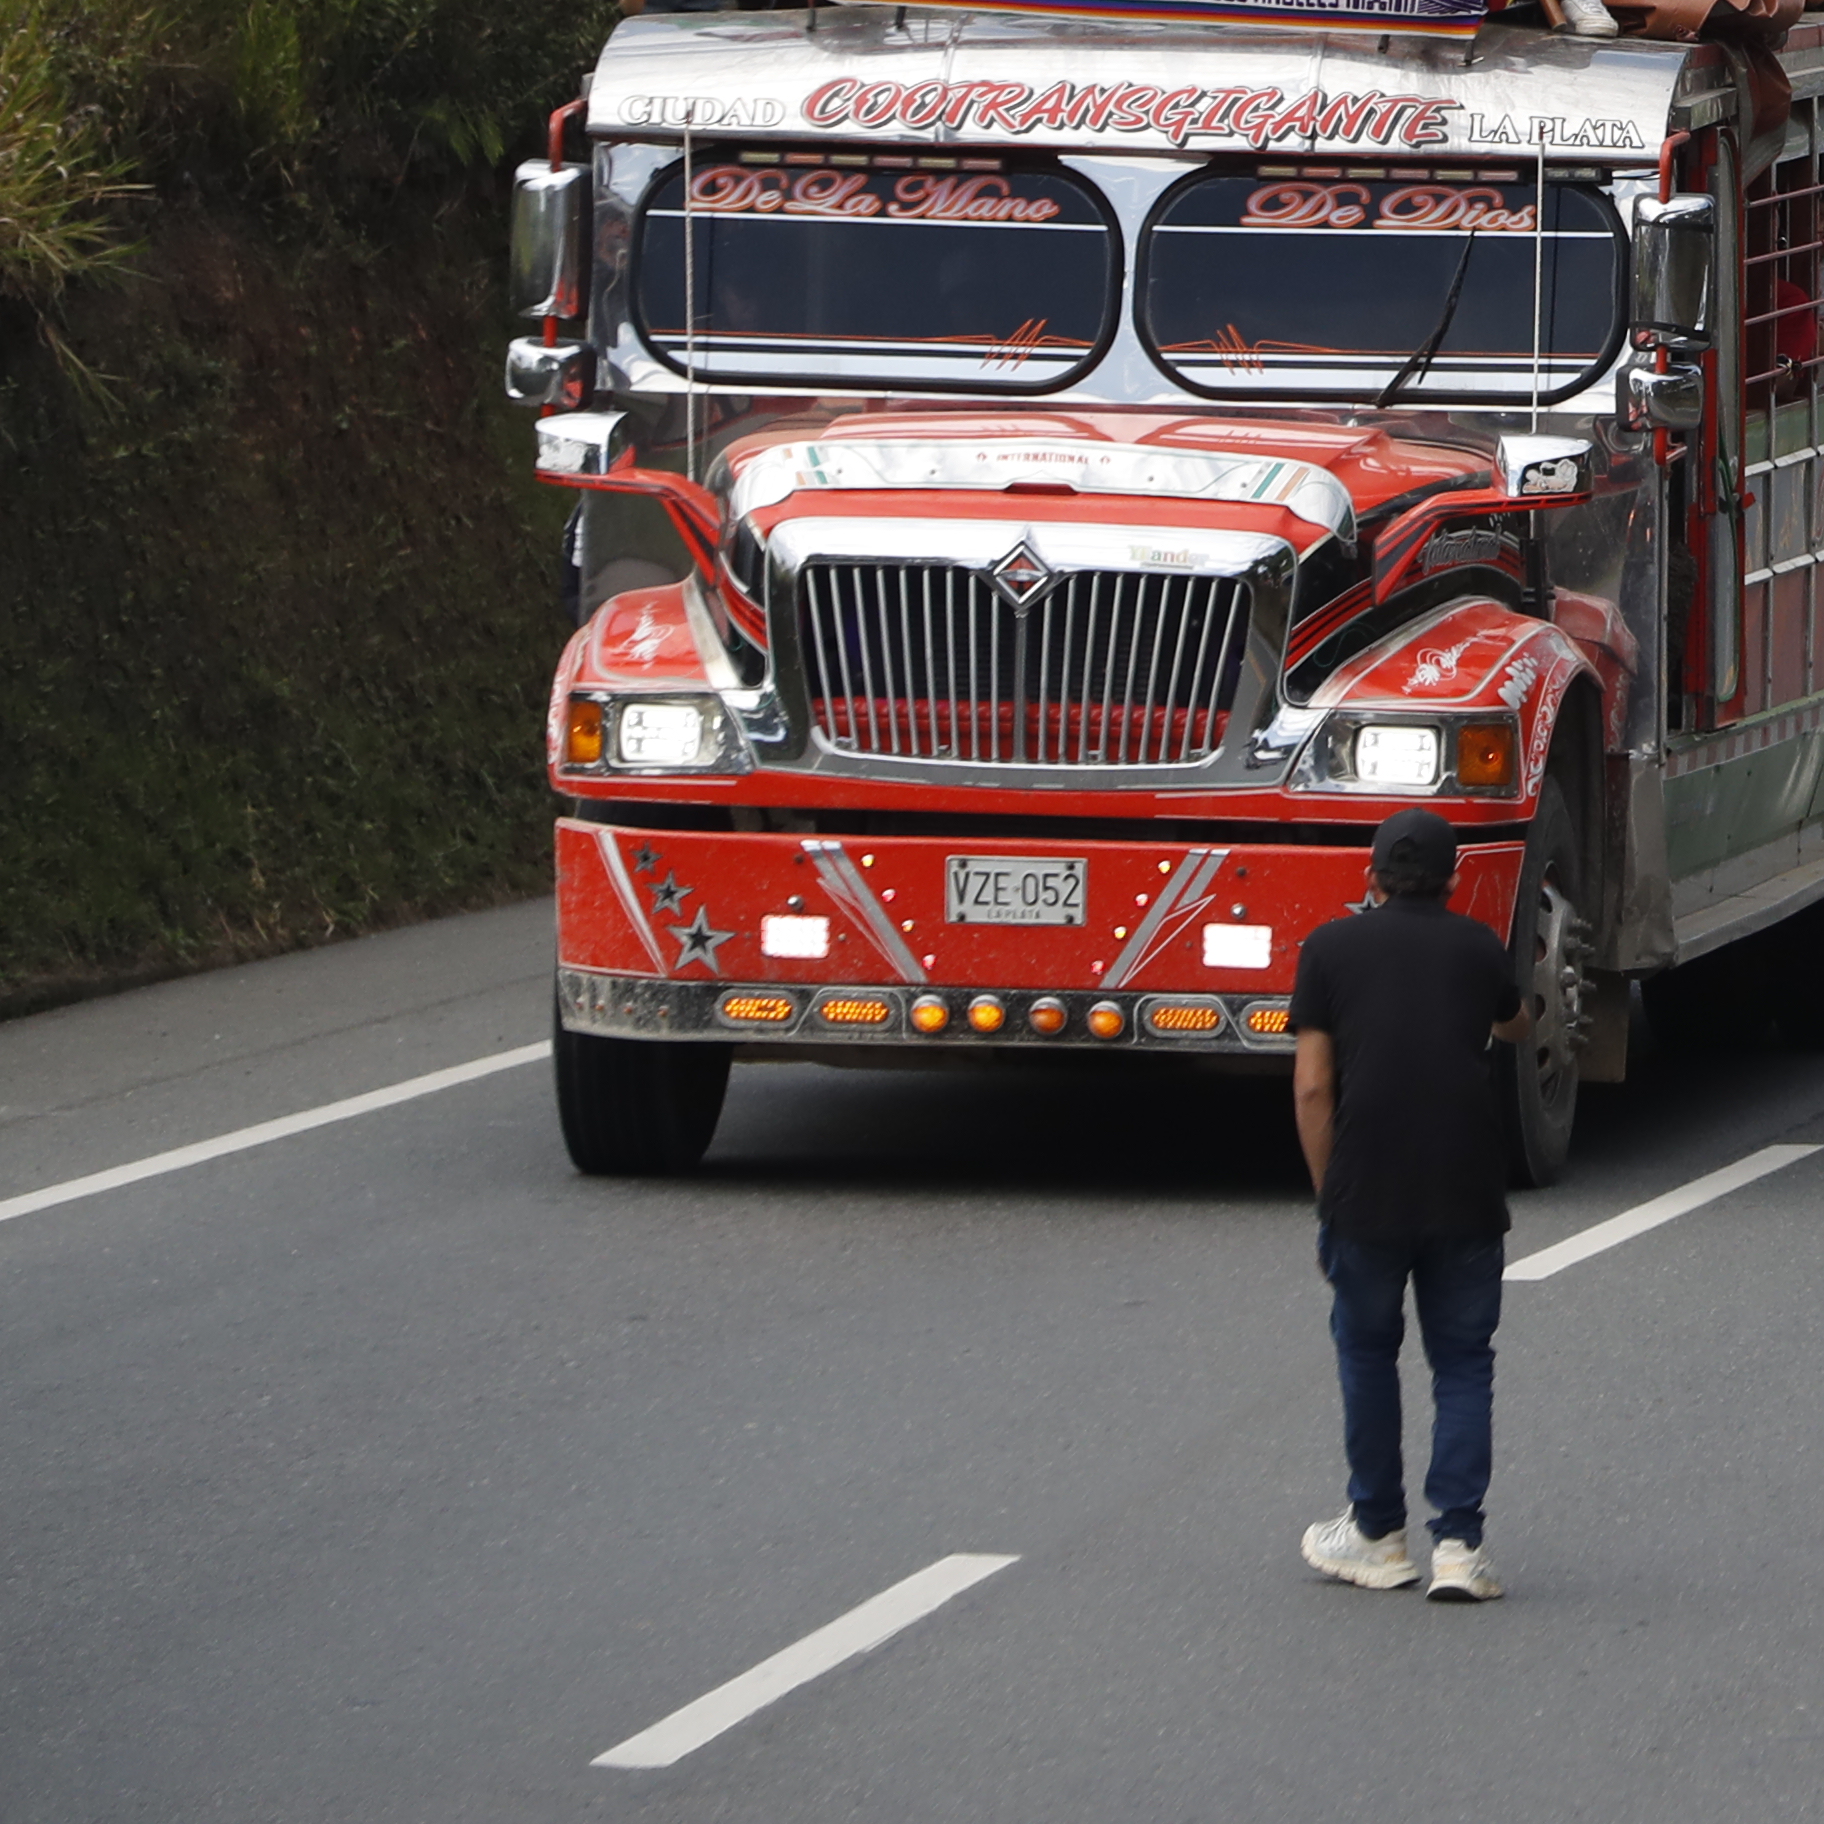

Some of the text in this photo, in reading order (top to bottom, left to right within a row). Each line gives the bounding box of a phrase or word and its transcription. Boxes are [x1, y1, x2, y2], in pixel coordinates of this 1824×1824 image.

[617, 94, 786, 128] CIUDAD
[800, 77, 1465, 150] COOTRANSGIGANTE
[1469, 112, 1646, 149] LA PLATA
[685, 165, 1061, 223] De La Mano
[1240, 180, 1537, 231] De Dios
[995, 451, 1090, 465] INTERNATIONAL
